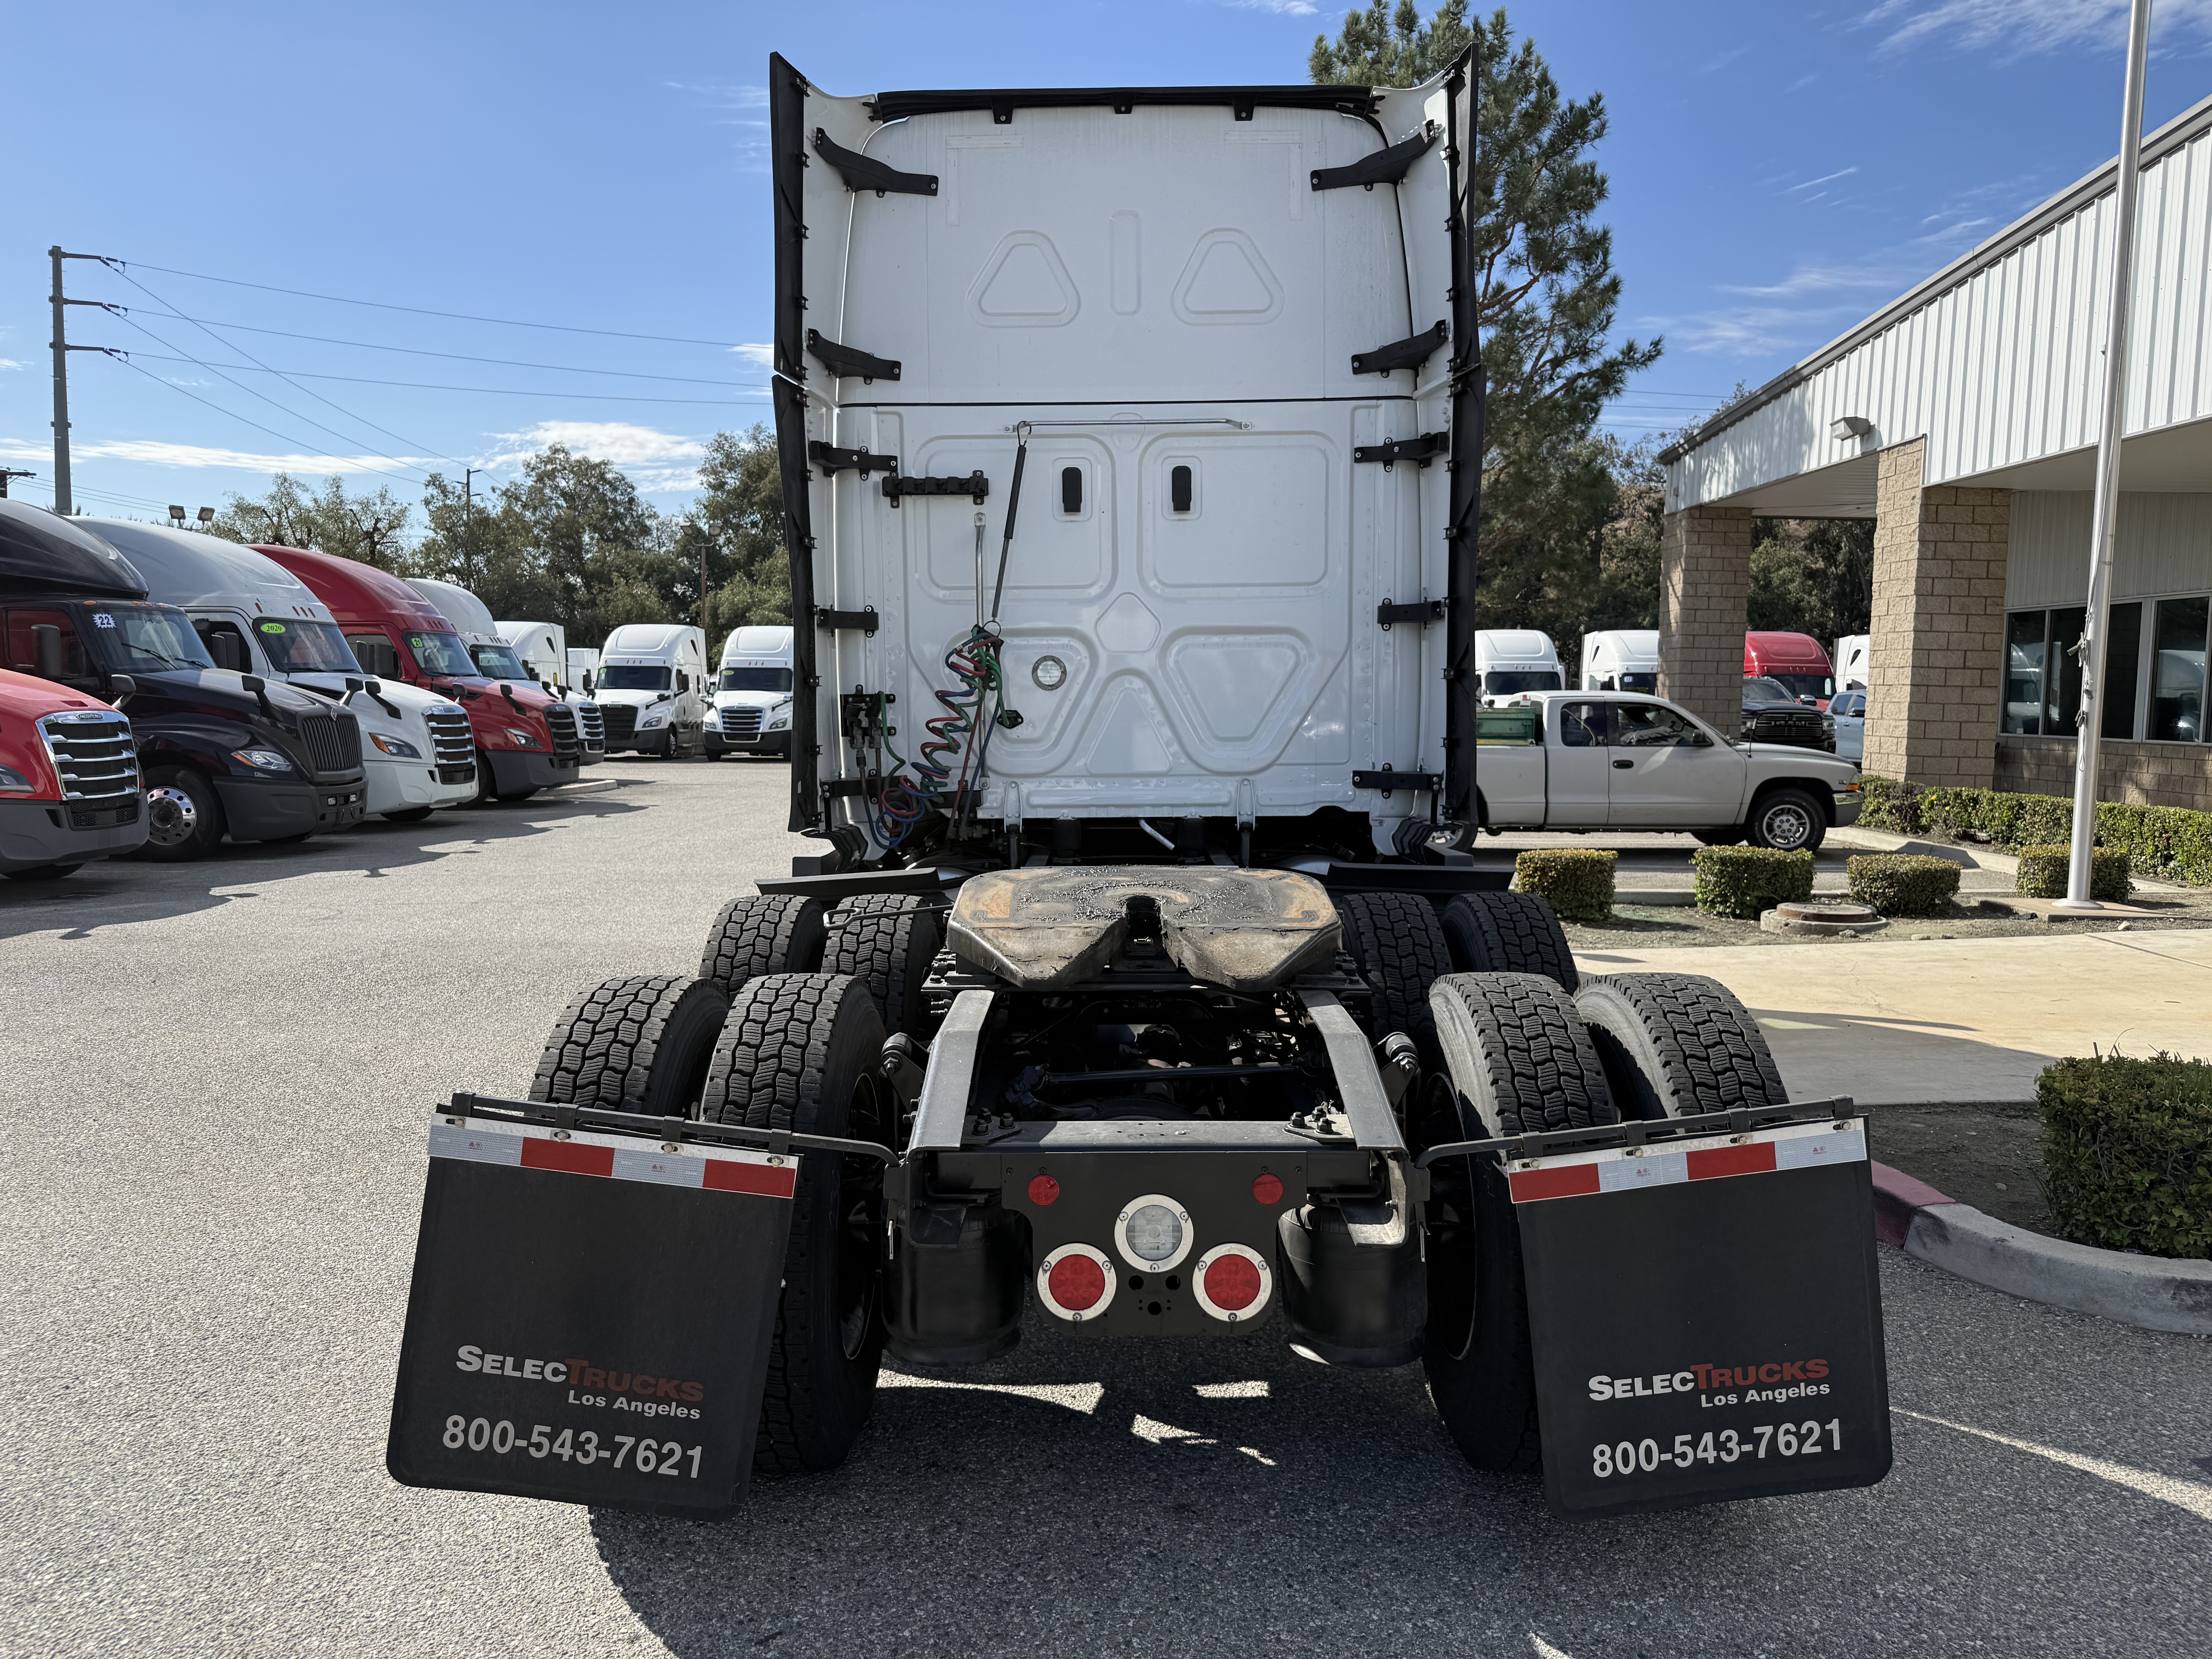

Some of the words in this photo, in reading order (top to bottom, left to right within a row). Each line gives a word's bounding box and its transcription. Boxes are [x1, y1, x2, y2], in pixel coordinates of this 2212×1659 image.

[99, 616, 112, 625] 22
[568, 1390, 606, 1407] Los
[612, 1396, 701, 1420] Angeles
[1701, 1394, 1738, 1408] Los
[1745, 1382, 1830, 1403] Angeles
[443, 1415, 702, 1478] 800-543-7621
[1593, 1418, 1840, 1478] 800-543-7621
